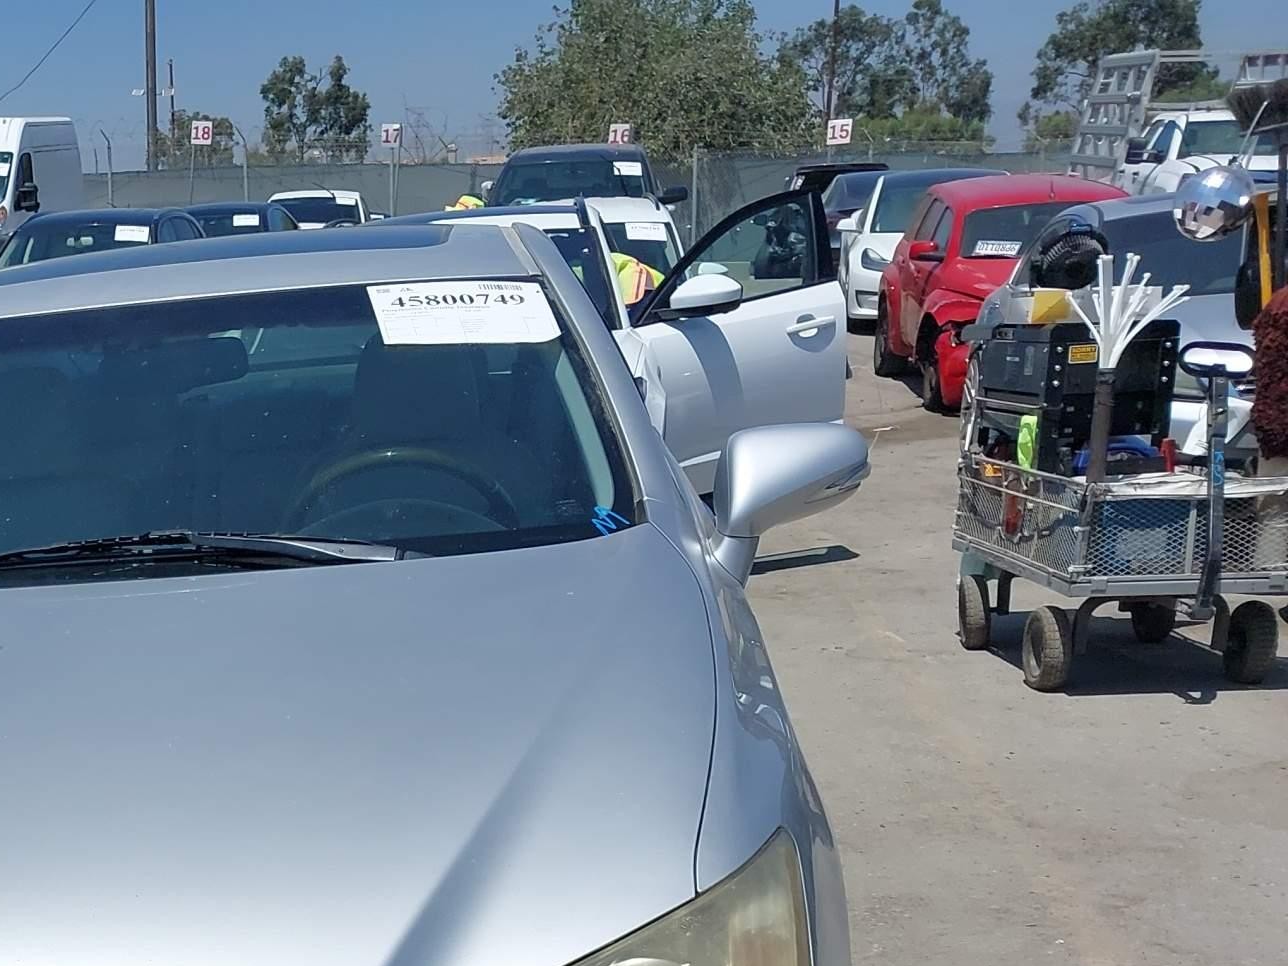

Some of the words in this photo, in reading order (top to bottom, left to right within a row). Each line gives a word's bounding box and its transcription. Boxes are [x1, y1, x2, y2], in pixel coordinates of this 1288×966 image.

[192, 126, 211, 140] 18
[382, 128, 400, 143] 17
[611, 128, 630, 144] 16
[828, 125, 849, 140] 15
[391, 293, 526, 308] 45800749
